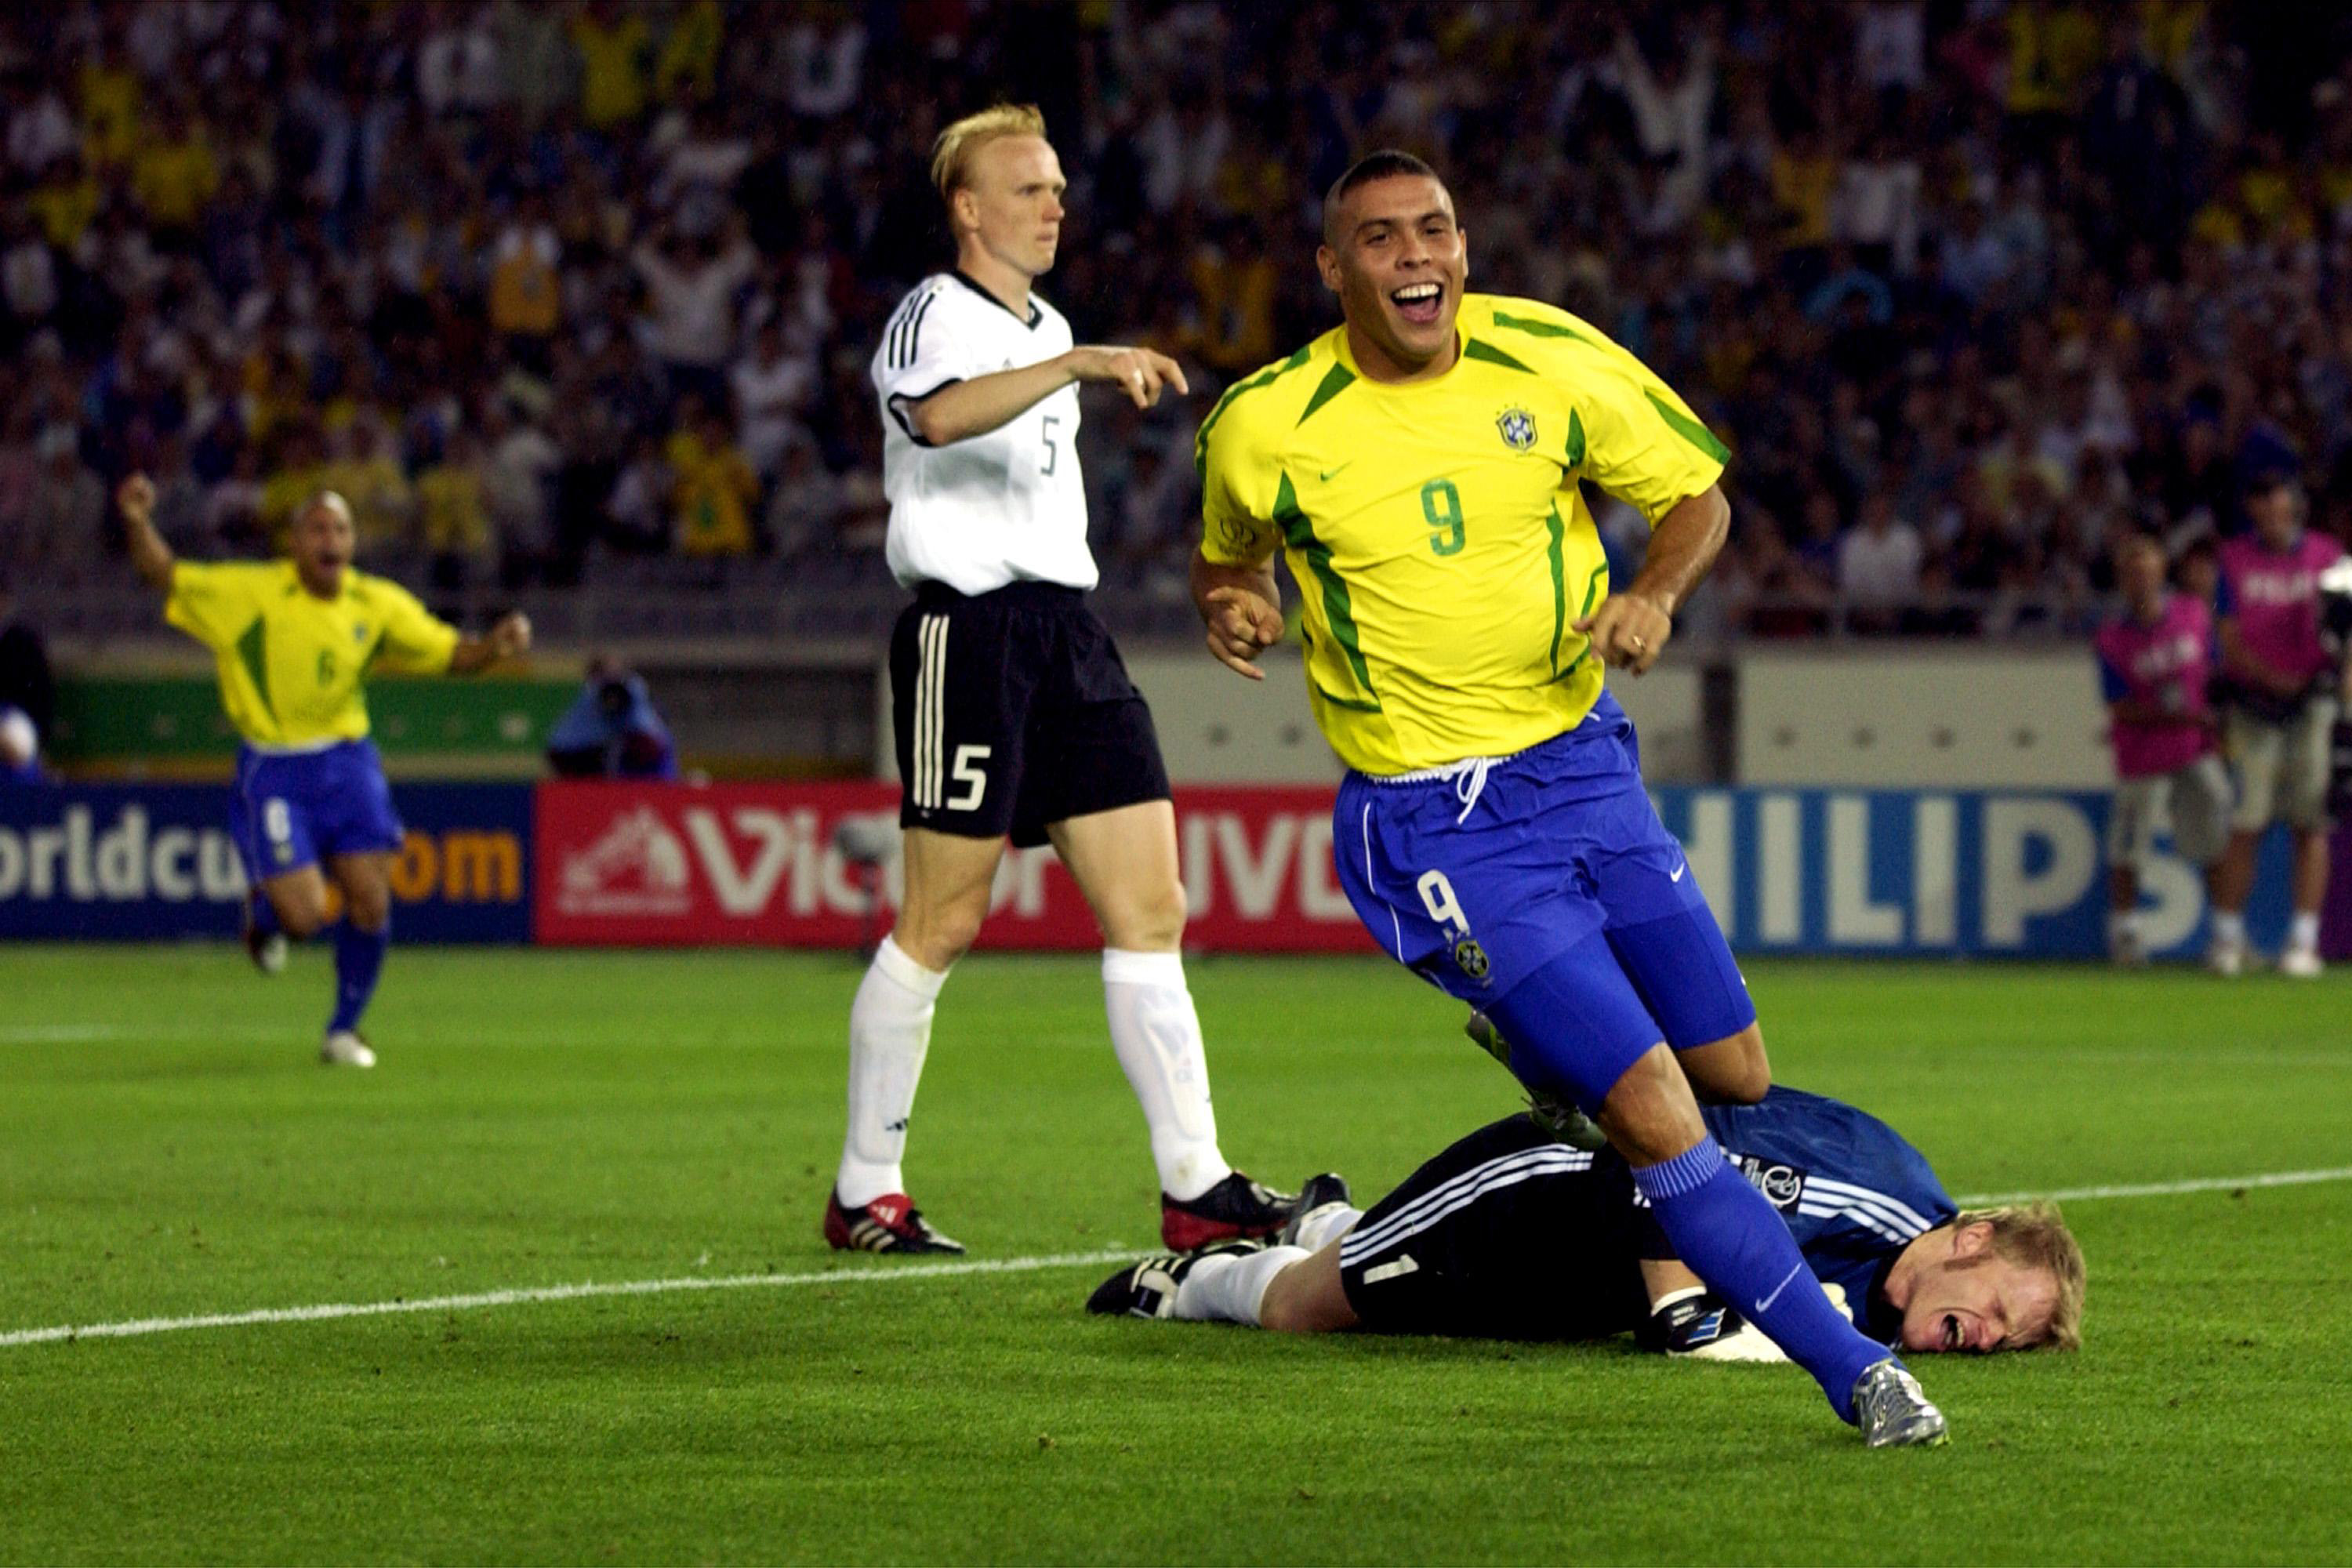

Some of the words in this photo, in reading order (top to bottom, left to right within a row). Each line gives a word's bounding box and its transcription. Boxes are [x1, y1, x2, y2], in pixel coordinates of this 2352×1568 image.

[1040, 416, 1060, 477] 5
[1421, 477, 1466, 557] 9
[947, 744, 992, 811] 5
[1417, 869, 1471, 943] 9
[1363, 1253, 1420, 1285] 1
